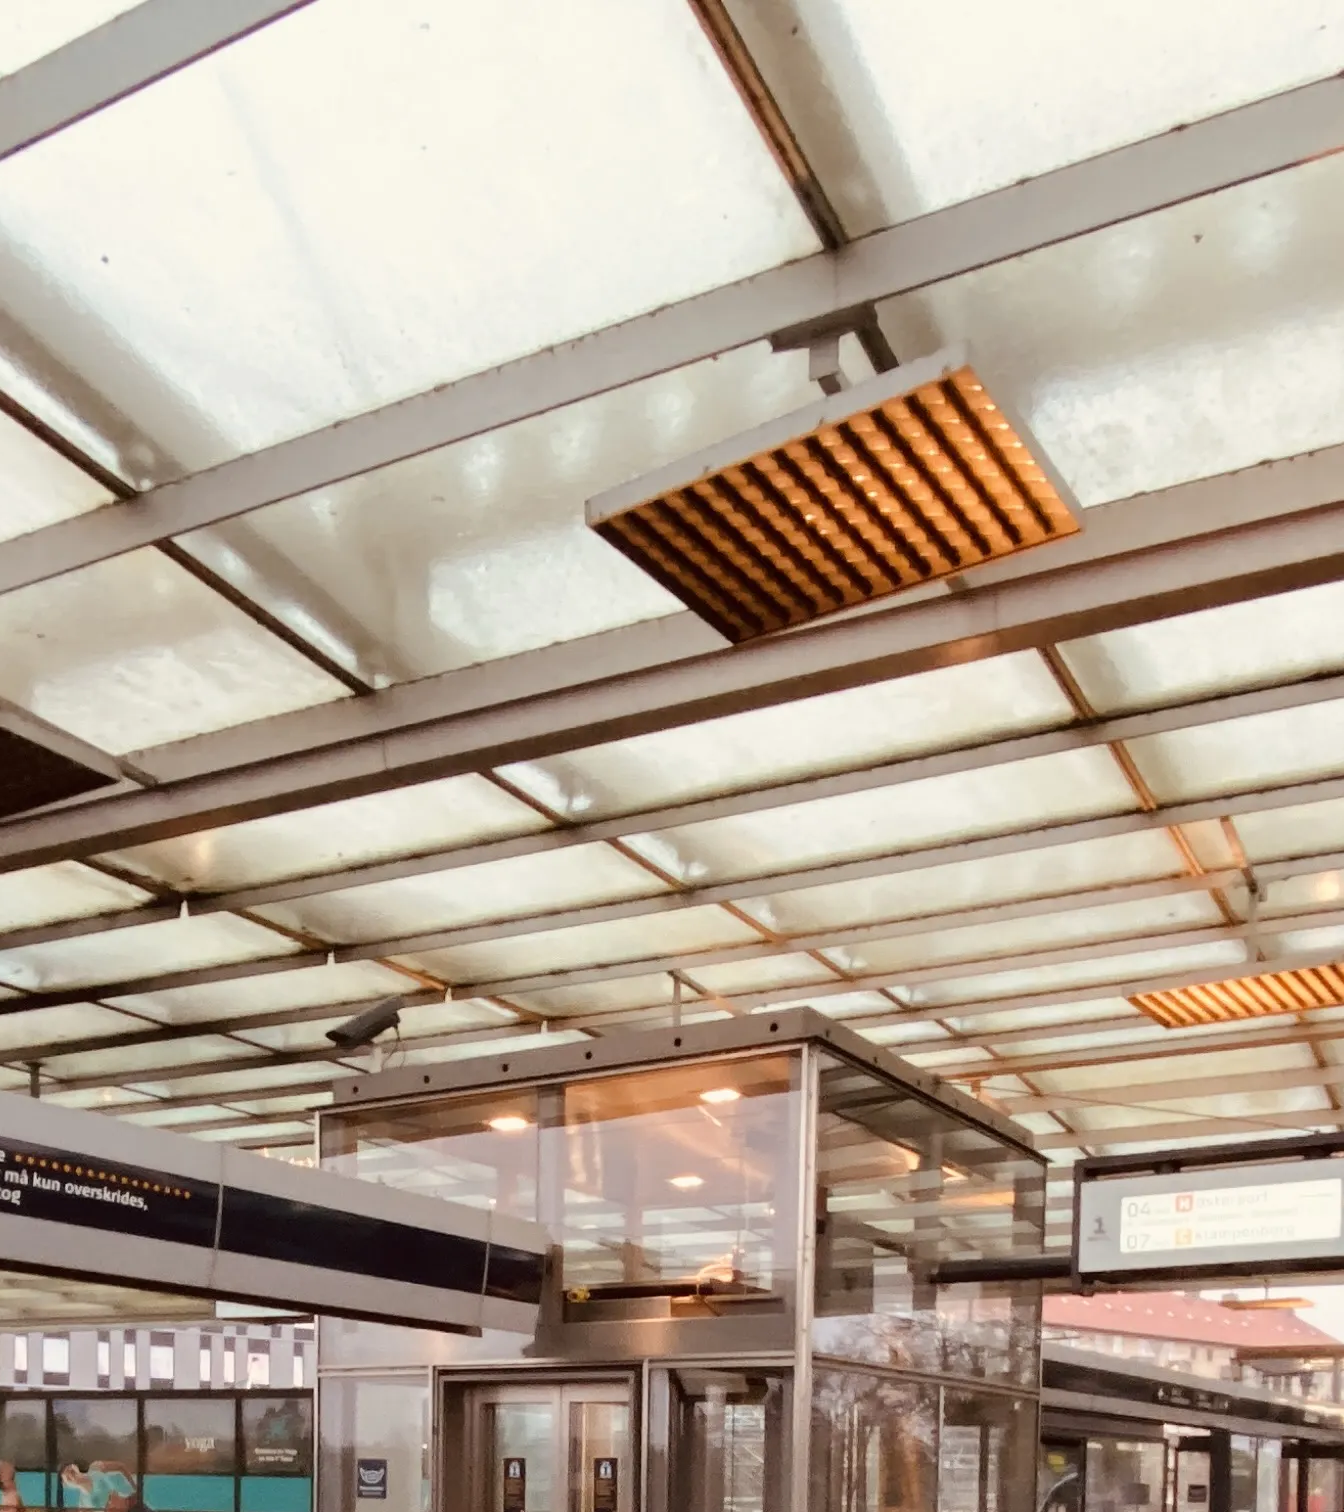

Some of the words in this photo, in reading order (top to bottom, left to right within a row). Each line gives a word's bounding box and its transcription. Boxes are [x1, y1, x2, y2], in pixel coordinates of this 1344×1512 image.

[5, 1168, 29, 1186] må
[32, 1171, 61, 1192] kun
[64, 1183, 149, 1211] overskrides,
[1126, 1201, 1152, 1218] 04
[1093, 1216, 1106, 1235] 1
[1126, 1233, 1152, 1250] 07
